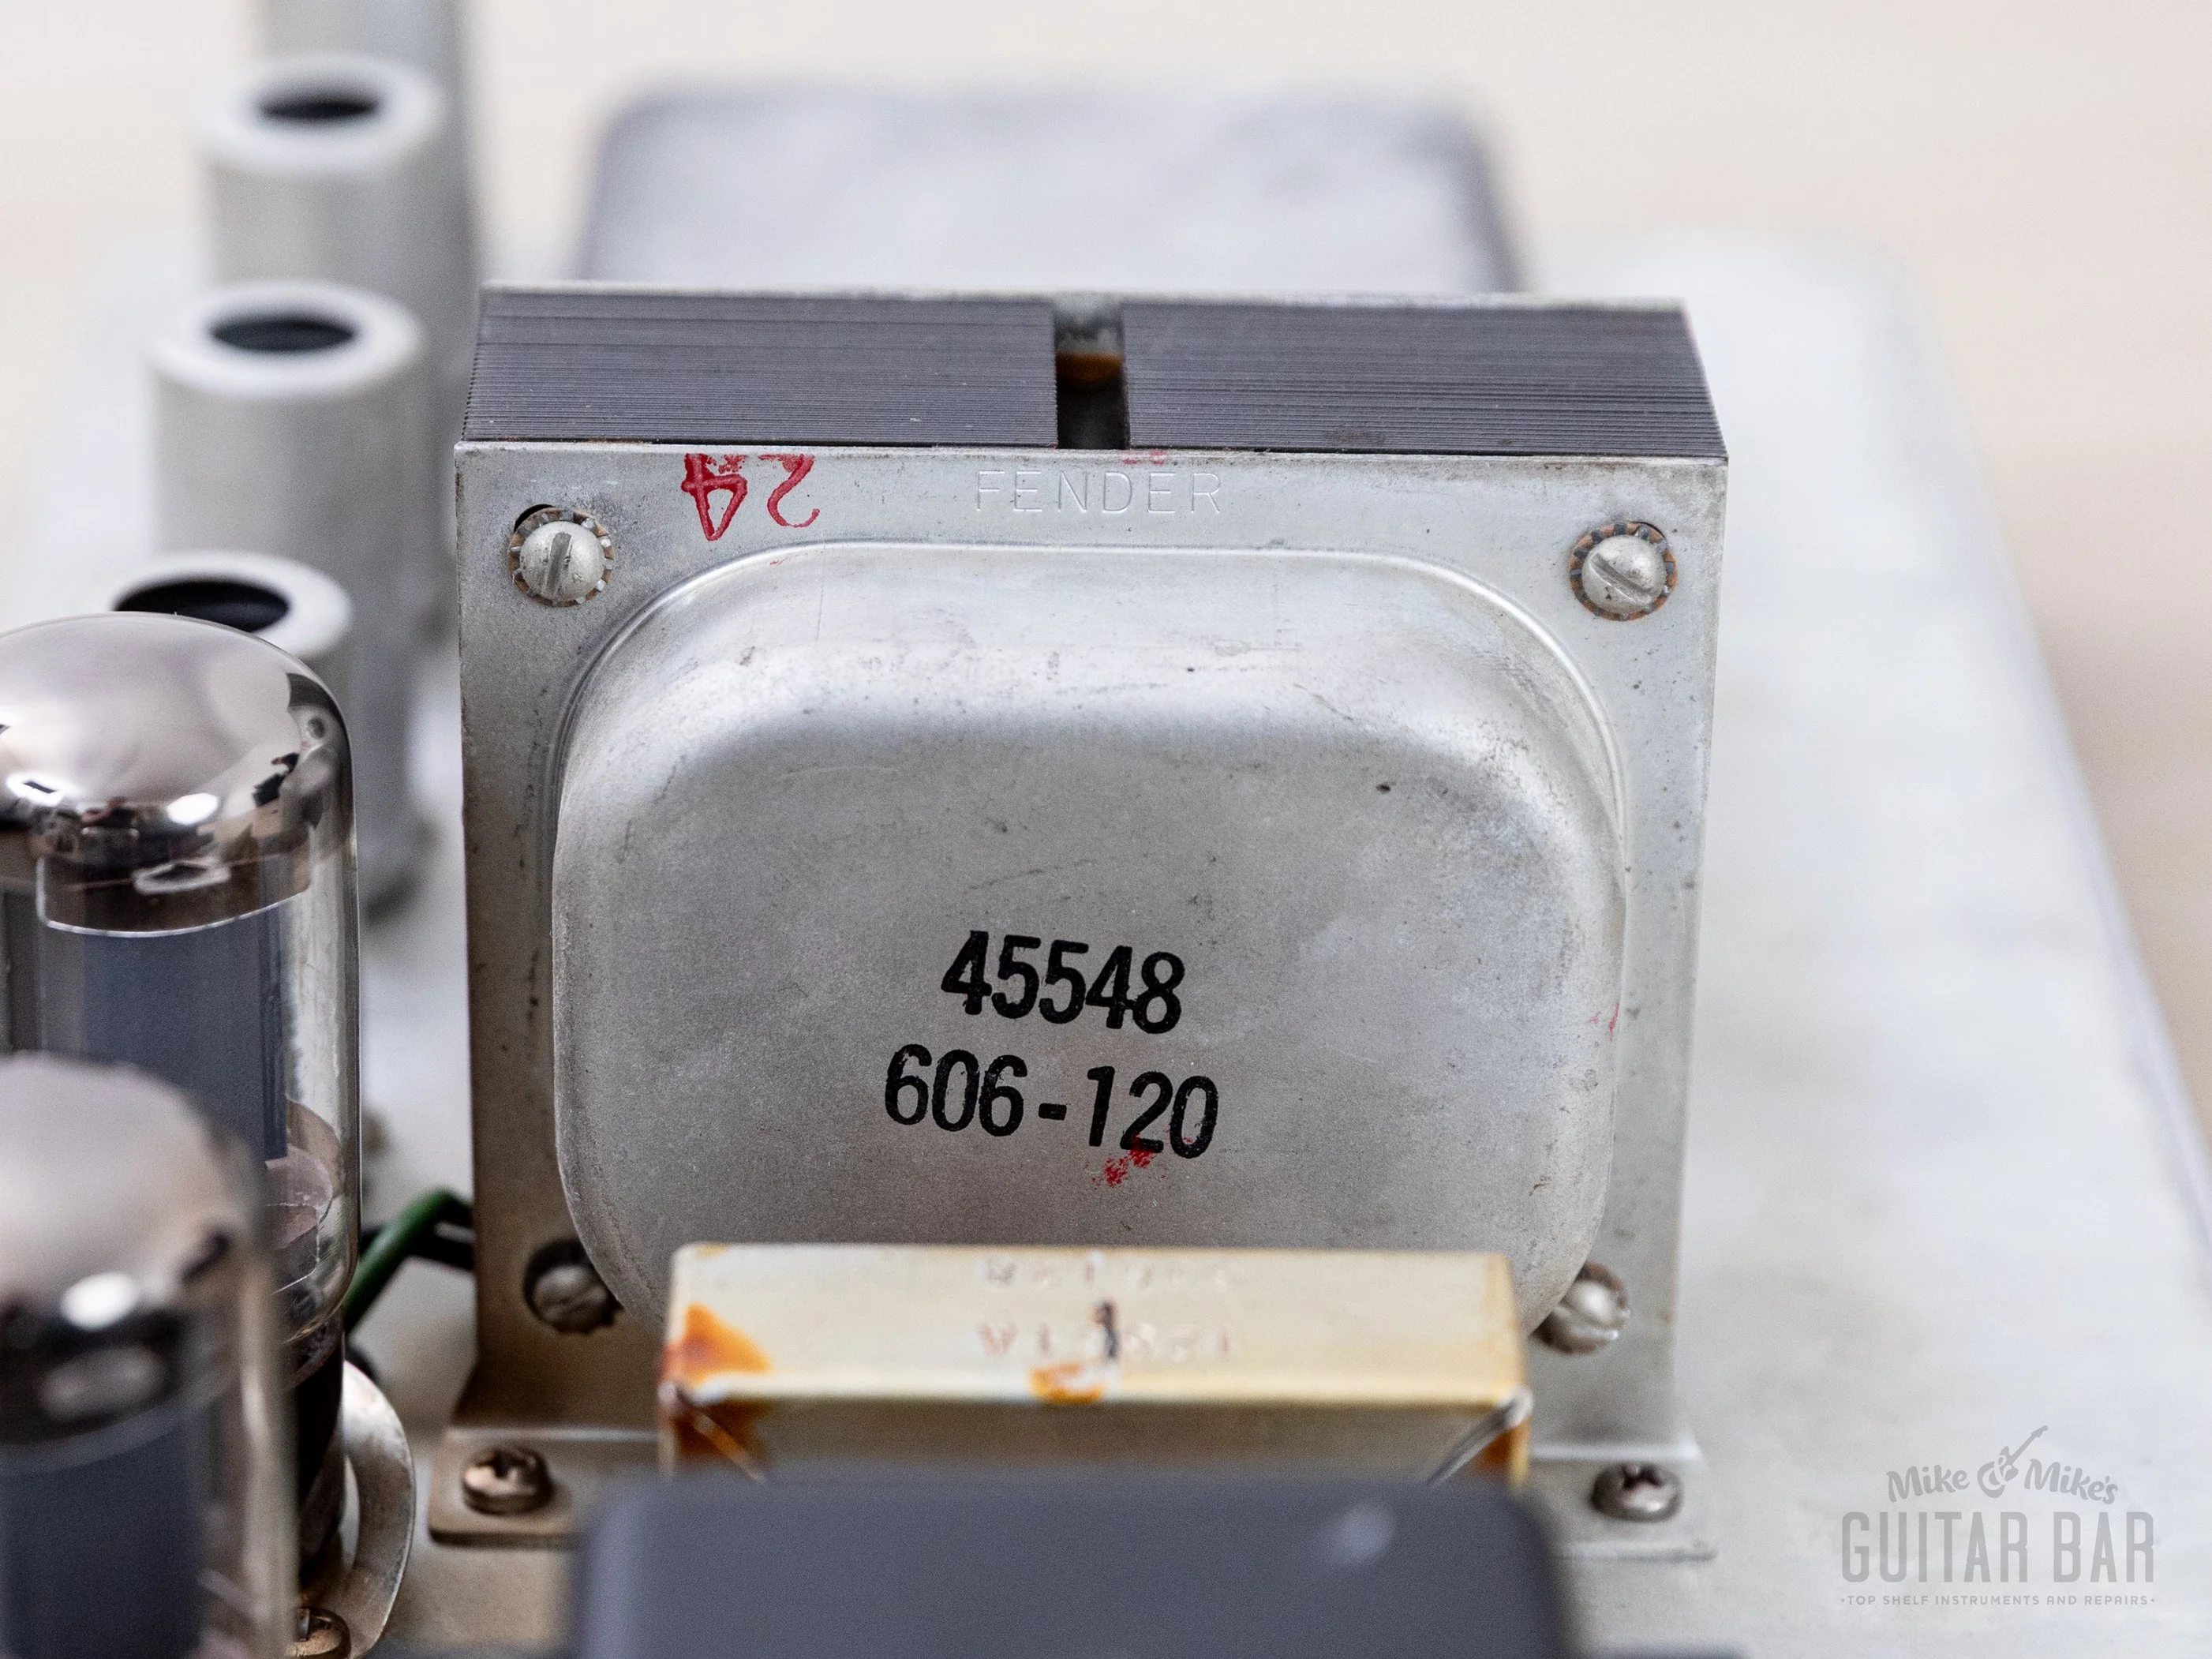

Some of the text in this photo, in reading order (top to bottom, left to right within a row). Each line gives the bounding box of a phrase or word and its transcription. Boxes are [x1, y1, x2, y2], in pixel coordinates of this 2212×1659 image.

[976, 470, 1221, 514] FENDER
[941, 931, 1185, 1034] 45548
[885, 1043, 1219, 1159] 606-120
